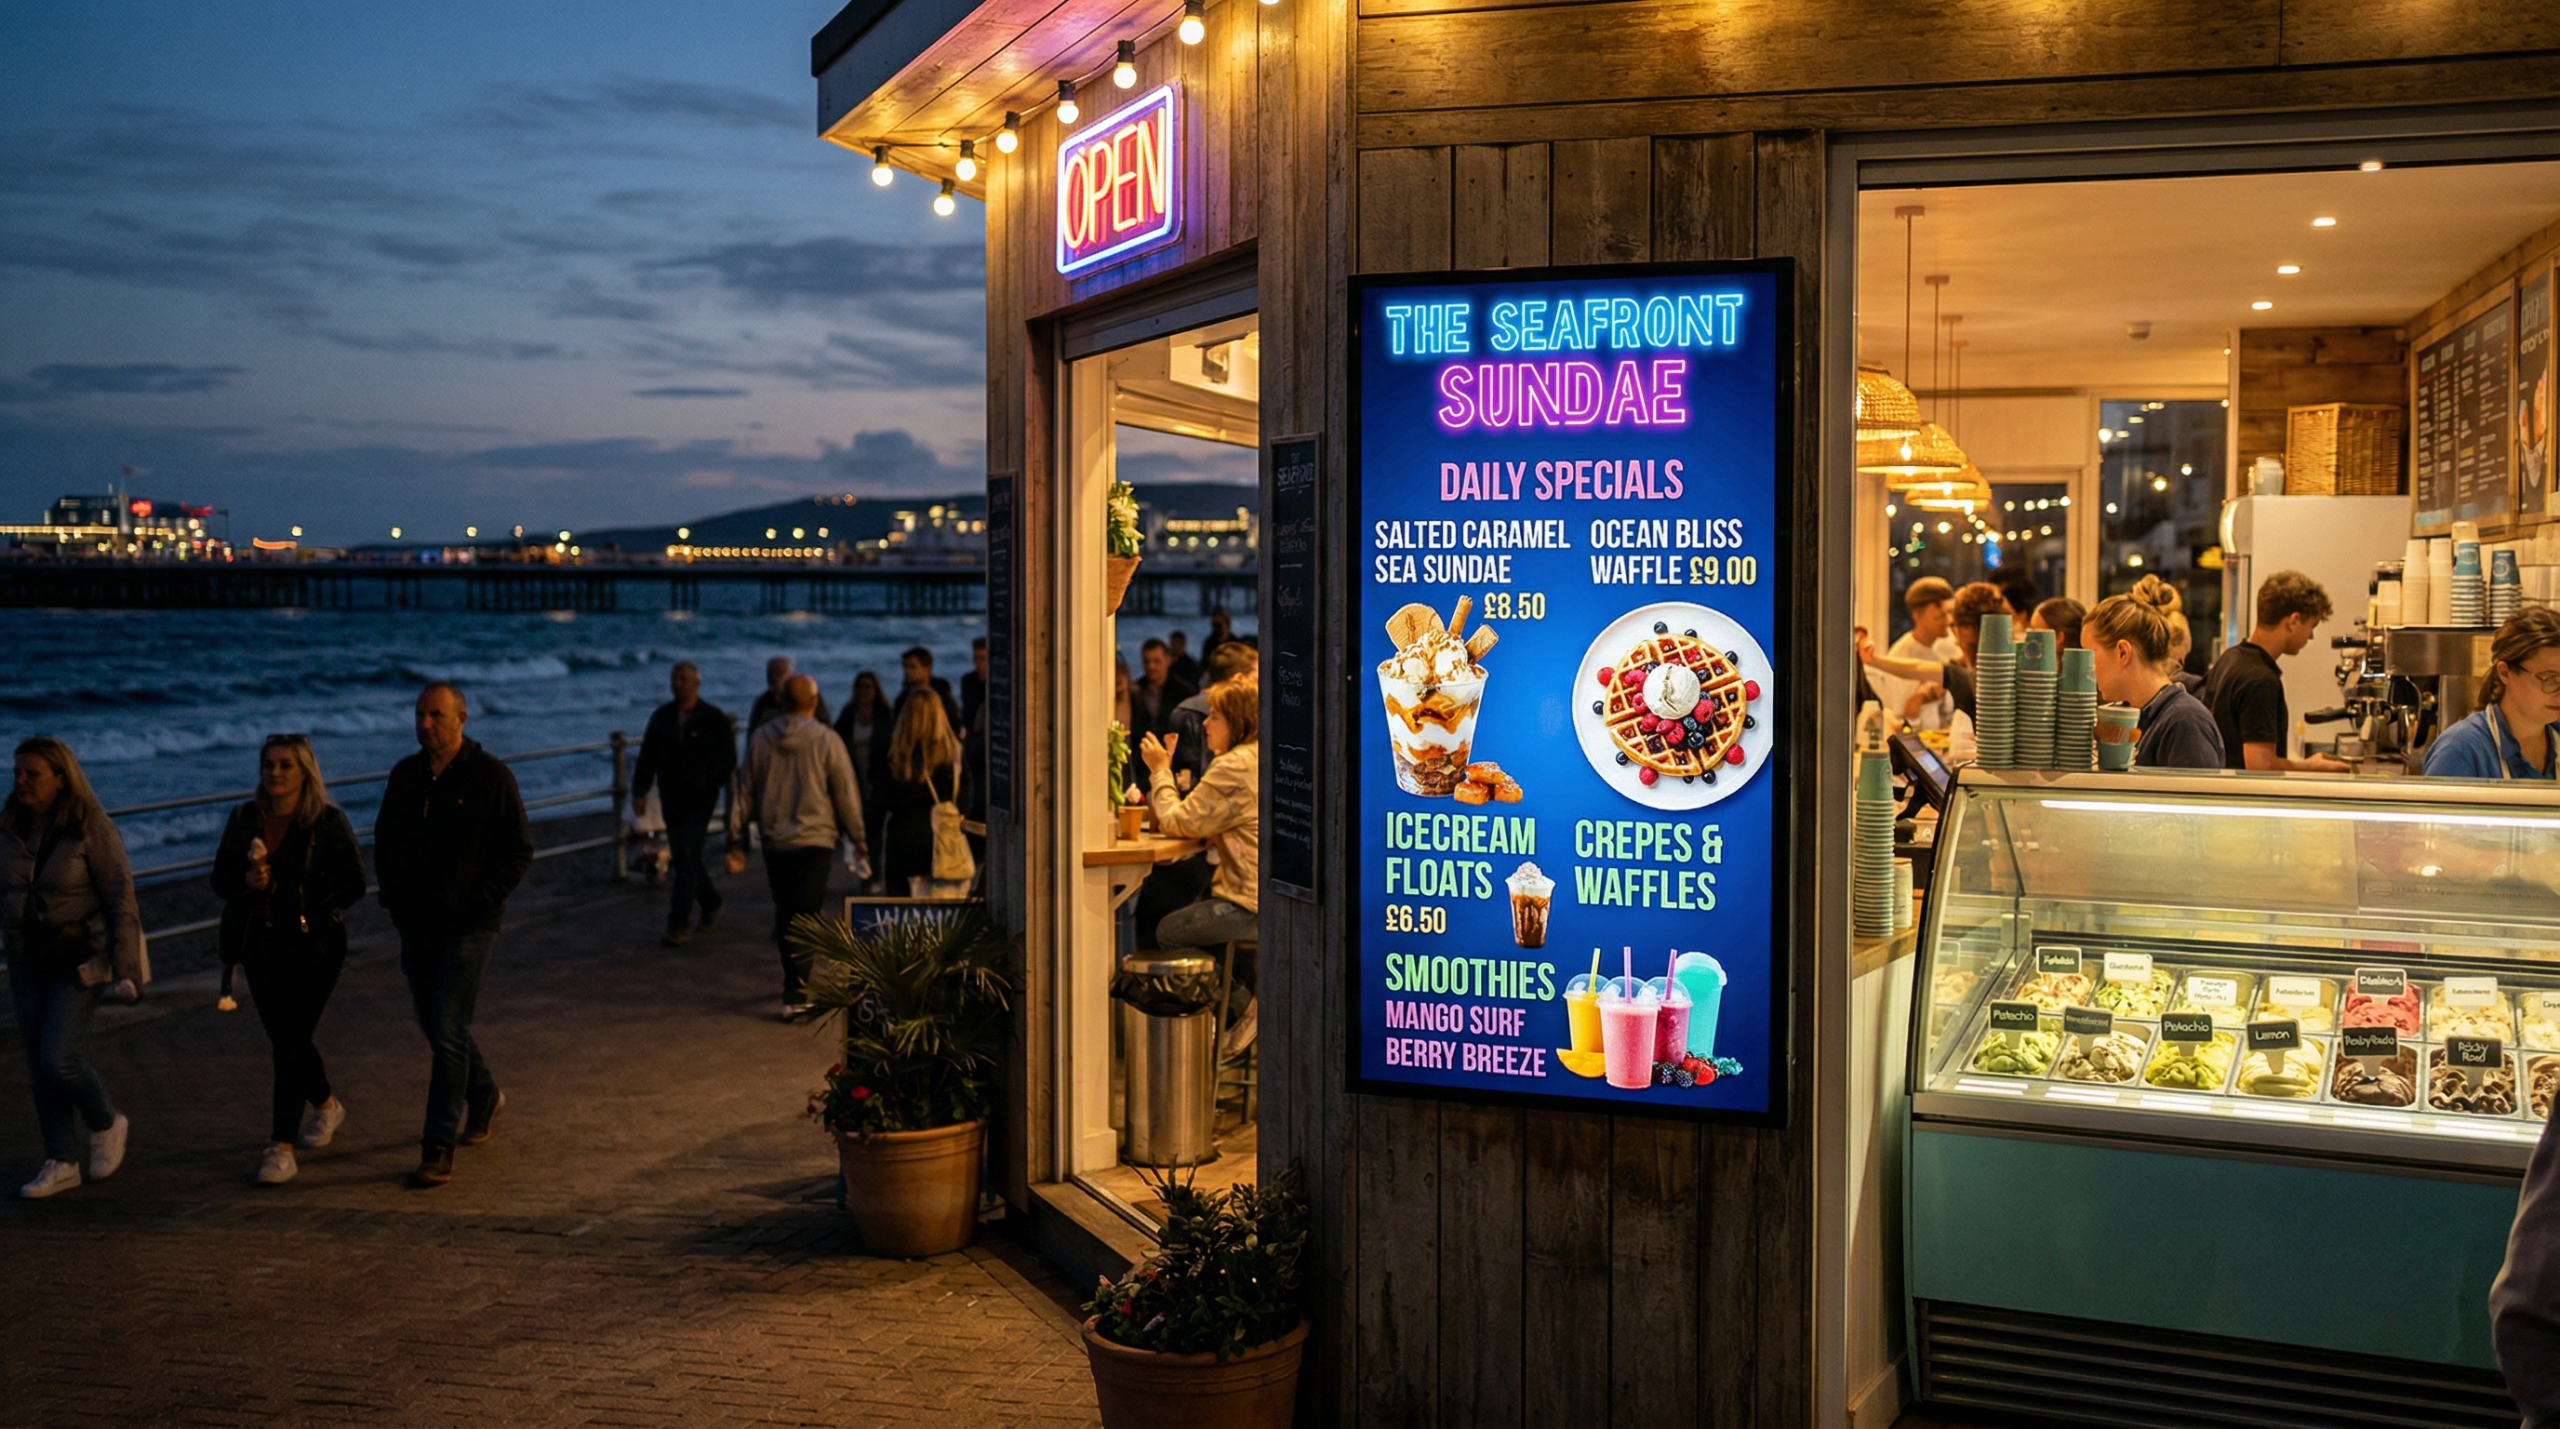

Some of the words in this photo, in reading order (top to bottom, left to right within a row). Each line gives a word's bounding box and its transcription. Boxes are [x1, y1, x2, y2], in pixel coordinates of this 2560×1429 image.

[1063, 107, 1166, 250] OPEN
[1386, 303, 1470, 355] THE
[1490, 293, 1744, 352] SEAFRONT
[1438, 359, 1687, 429] SUNDAE
[1440, 460, 1527, 502] DAILY
[1534, 458, 1685, 501] SPECIALS
[1374, 519, 1457, 550] SALTED
[1462, 519, 1571, 550] CARAMEL
[1590, 518, 1669, 550] OCEAN
[1675, 517, 1743, 549] BLISS
[1374, 554, 1418, 585] SEA
[1422, 554, 1512, 585] SUNDAE
[1590, 554, 1682, 586] WAFFLE
[1688, 554, 1757, 586] £9.00
[1483, 591, 1546, 621] £8.50
[1385, 811, 1536, 856] ICECREAM
[1574, 818, 1693, 865] CREPES
[1700, 824, 1724, 865] &
[1385, 856, 1494, 900] FLOATS
[1573, 865, 1717, 912] WAFFLES
[1385, 904, 1447, 935] £6.50
[1385, 952, 1556, 1002] SMOOTHIES
[1385, 1000, 1464, 1035] MANGO
[1469, 1005, 1527, 1038] SURF
[1385, 1036, 1457, 1071] BERRY
[1462, 1043, 1548, 1079] BREEZE
